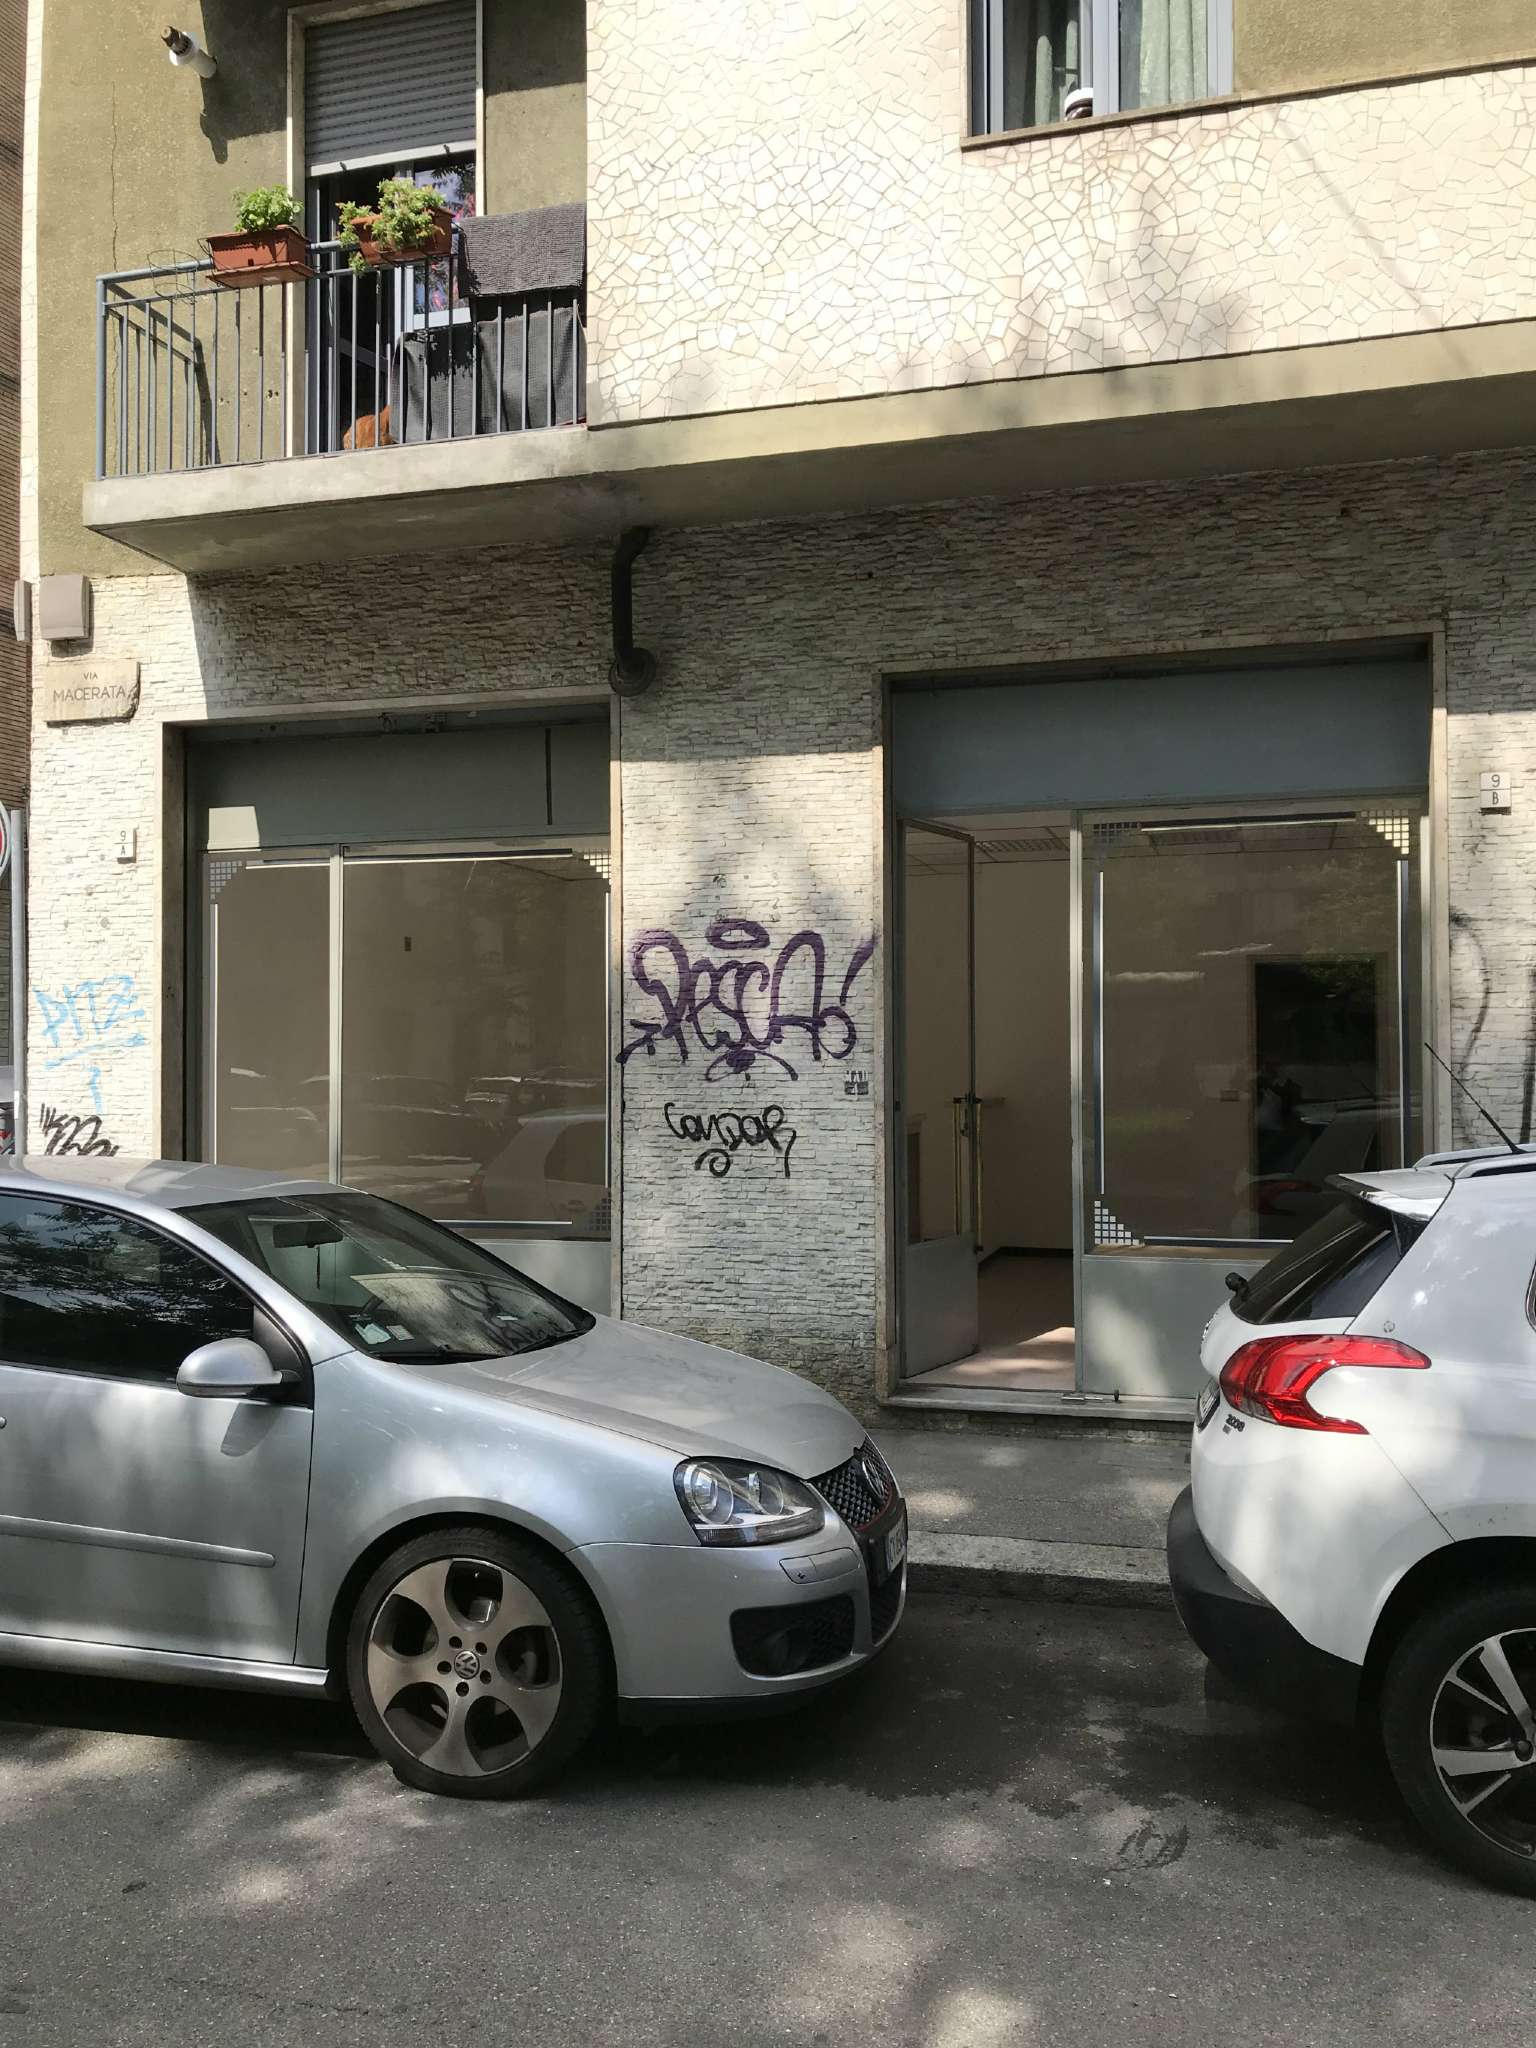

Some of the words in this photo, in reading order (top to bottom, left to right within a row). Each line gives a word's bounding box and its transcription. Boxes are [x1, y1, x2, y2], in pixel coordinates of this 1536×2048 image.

[83, 671, 98, 680] VIA
[53, 685, 126, 702] MACERATA
[1491, 774, 1500, 788] 9
[1492, 791, 1500, 805] B
[120, 830, 126, 841] 9
